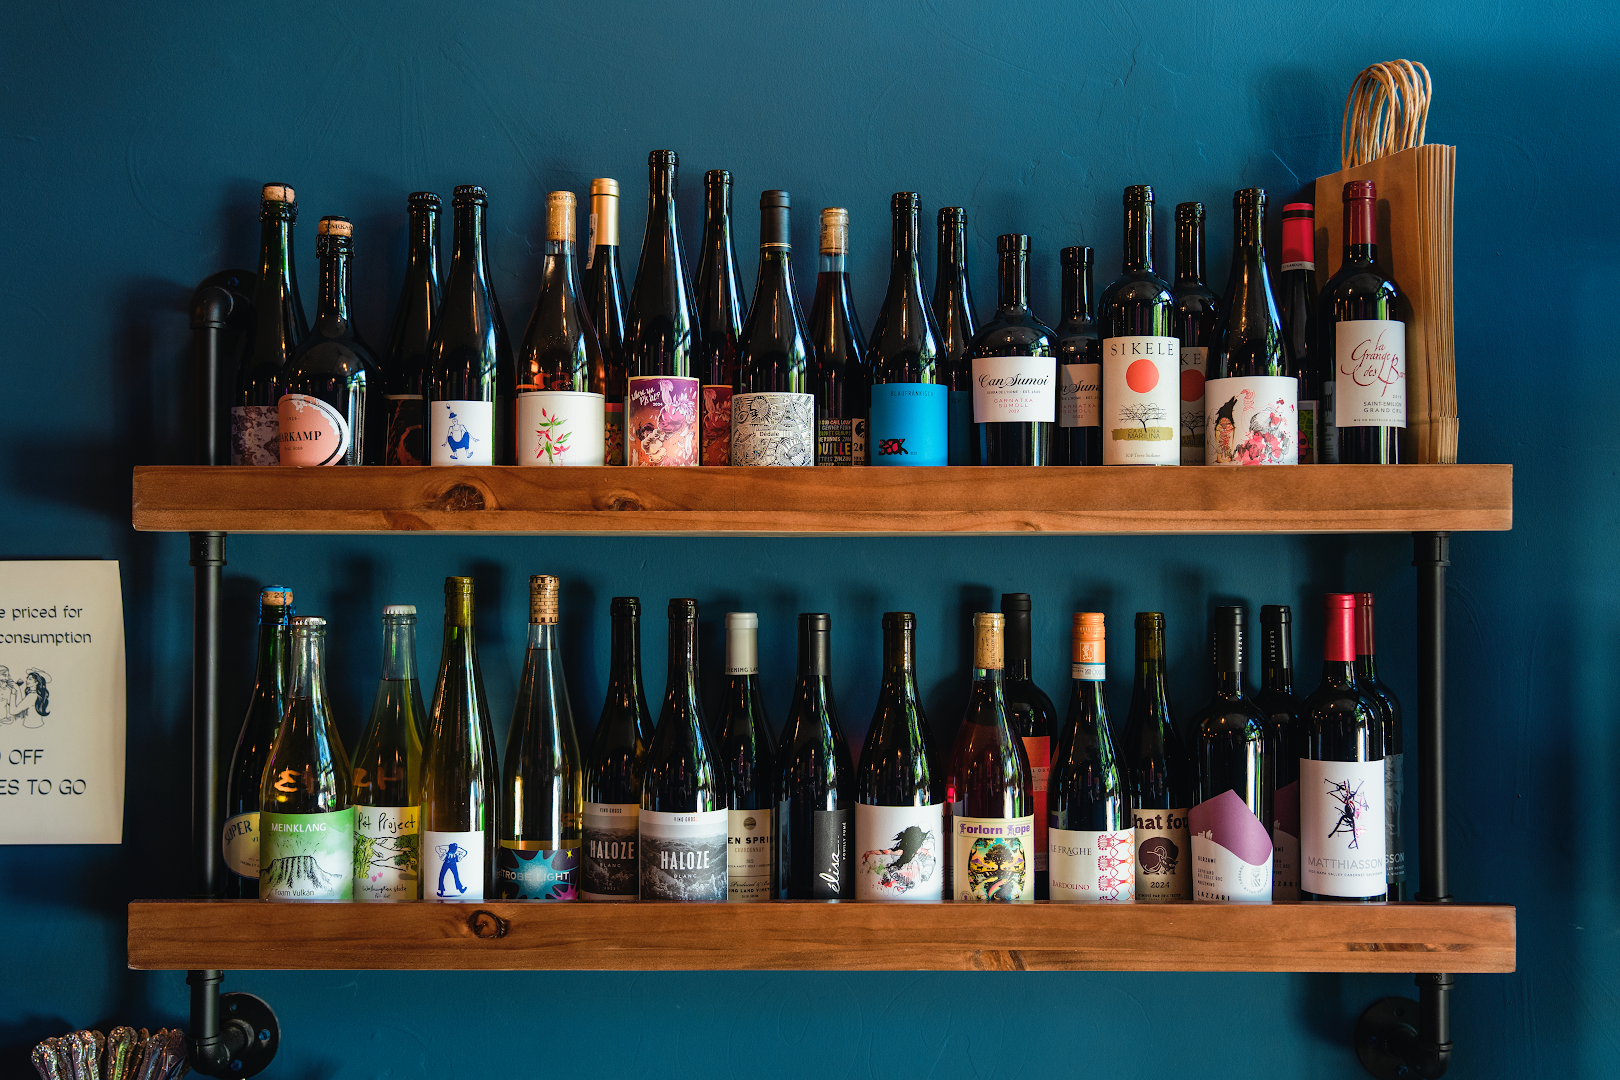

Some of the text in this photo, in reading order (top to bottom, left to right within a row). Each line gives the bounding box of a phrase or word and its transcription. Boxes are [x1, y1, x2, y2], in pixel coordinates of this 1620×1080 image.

[12, 605, 57, 621] priced
[63, 605, 83, 618] for
[9, 749, 44, 765] OFF
[27, 779, 52, 795] TO
[59, 779, 87, 795] GO
[378, 812, 416, 834] Project
[590, 840, 635, 860] HALOZE
[1058, 845, 1091, 857] FRAGHE
[660, 850, 710, 870] HALOZE
[1308, 856, 1383, 869] MATTHIASSON
[536, 871, 570, 882] LIGHT
[273, 888, 291, 897] Foam
[1150, 881, 1170, 889] 2024
